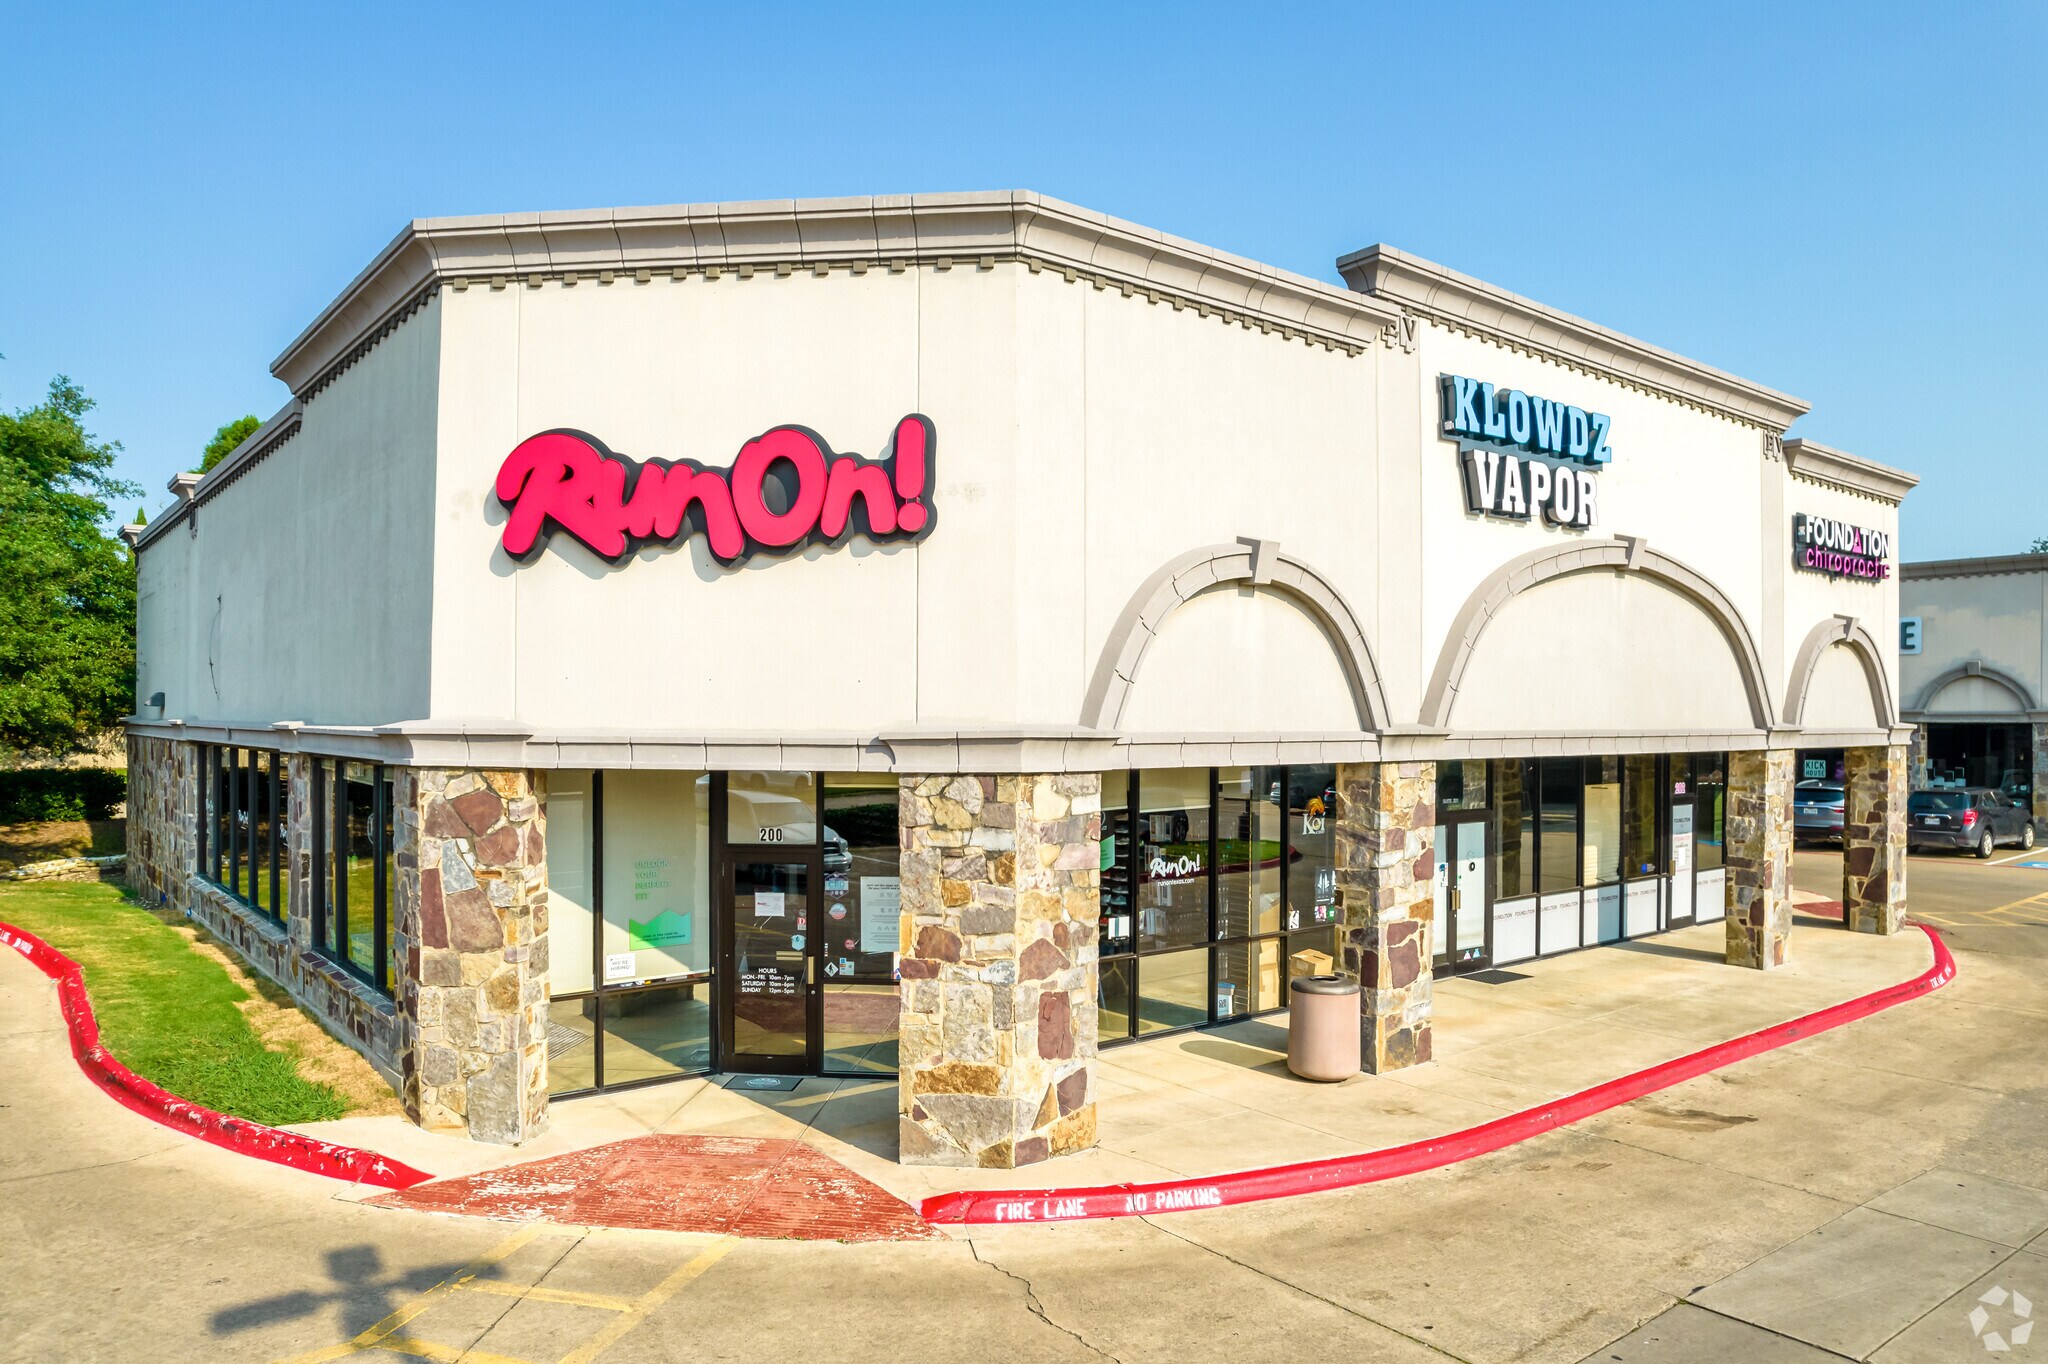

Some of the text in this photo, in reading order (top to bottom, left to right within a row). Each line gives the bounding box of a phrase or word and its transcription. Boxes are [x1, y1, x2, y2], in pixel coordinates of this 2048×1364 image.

[1453, 375, 1612, 463] KLOWDZ
[1473, 448, 1598, 526] VAPOR
[1806, 514, 1889, 559] FOUNDATION
[1807, 545, 1890, 579] chiropractic
[1806, 761, 1825, 770] KICK
[760, 828, 783, 842] 200
[1302, 811, 1326, 835] Koi
[635, 860, 669, 869] UNLOCK
[636, 871, 658, 879] YOUR
[996, 1187, 1221, 1221] FIRE LANE NO PARKING
